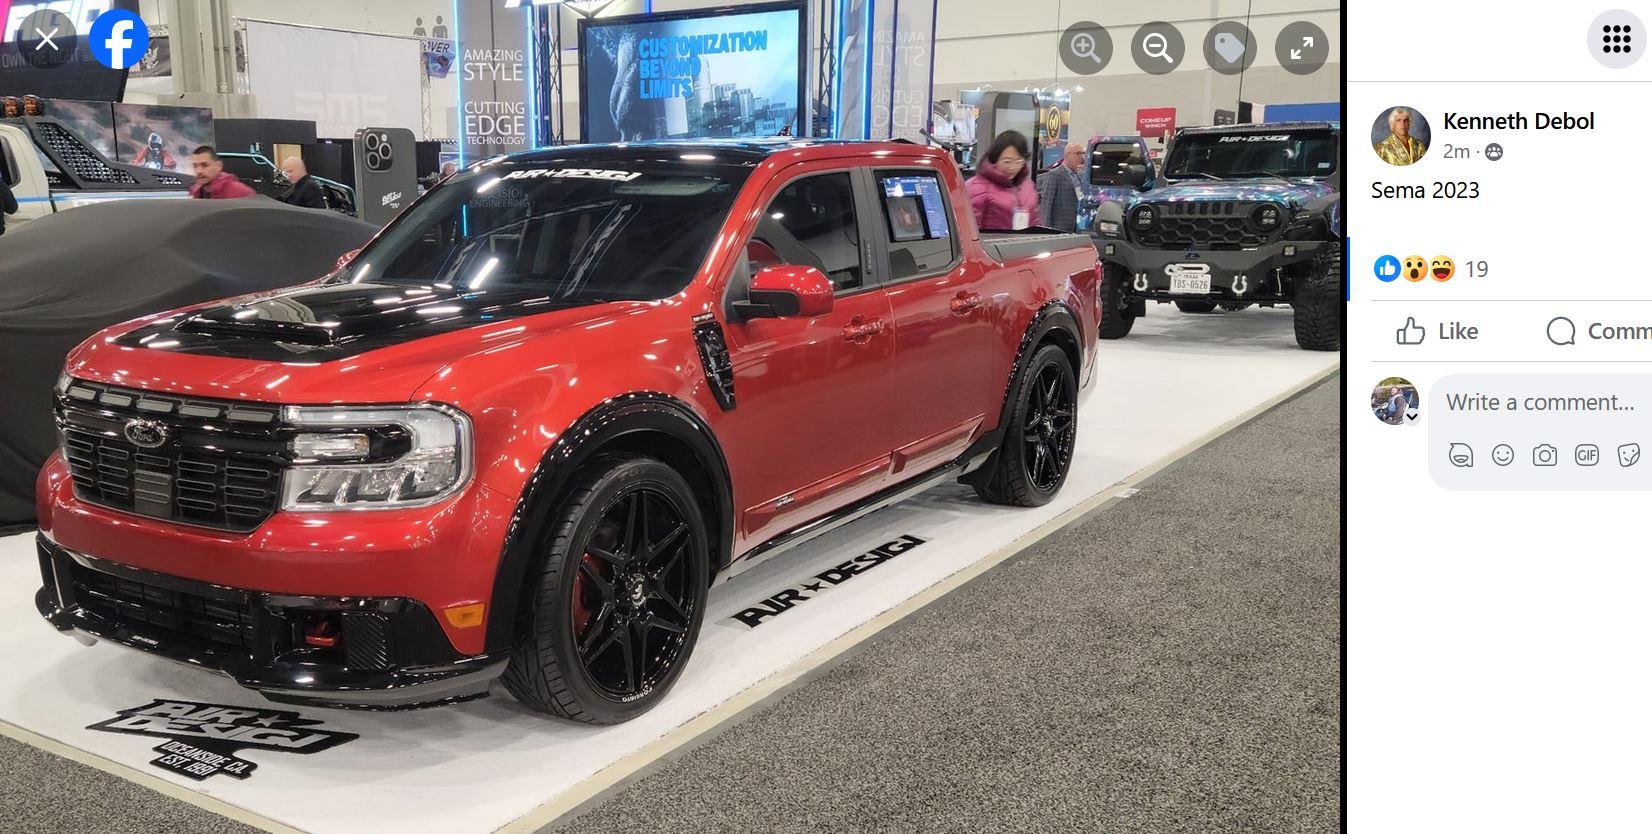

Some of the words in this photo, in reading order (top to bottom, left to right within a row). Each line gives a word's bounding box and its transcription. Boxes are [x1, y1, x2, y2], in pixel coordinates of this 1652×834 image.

[464, 49, 523, 61] AMAZING
[639, 30, 767, 59] CUSTOMIZATION
[464, 63, 523, 81] STYLE
[639, 56, 701, 78] BEYOND
[639, 77, 694, 99] LIMITS
[464, 102, 525, 114] CUTTING
[465, 116, 526, 135] EDGE
[132, 425, 156, 443] Ford
[731, 588, 811, 628] AIR
[134, 702, 260, 724] AIR
[158, 753, 192, 769] EST.
[183, 761, 219, 776] 1991
